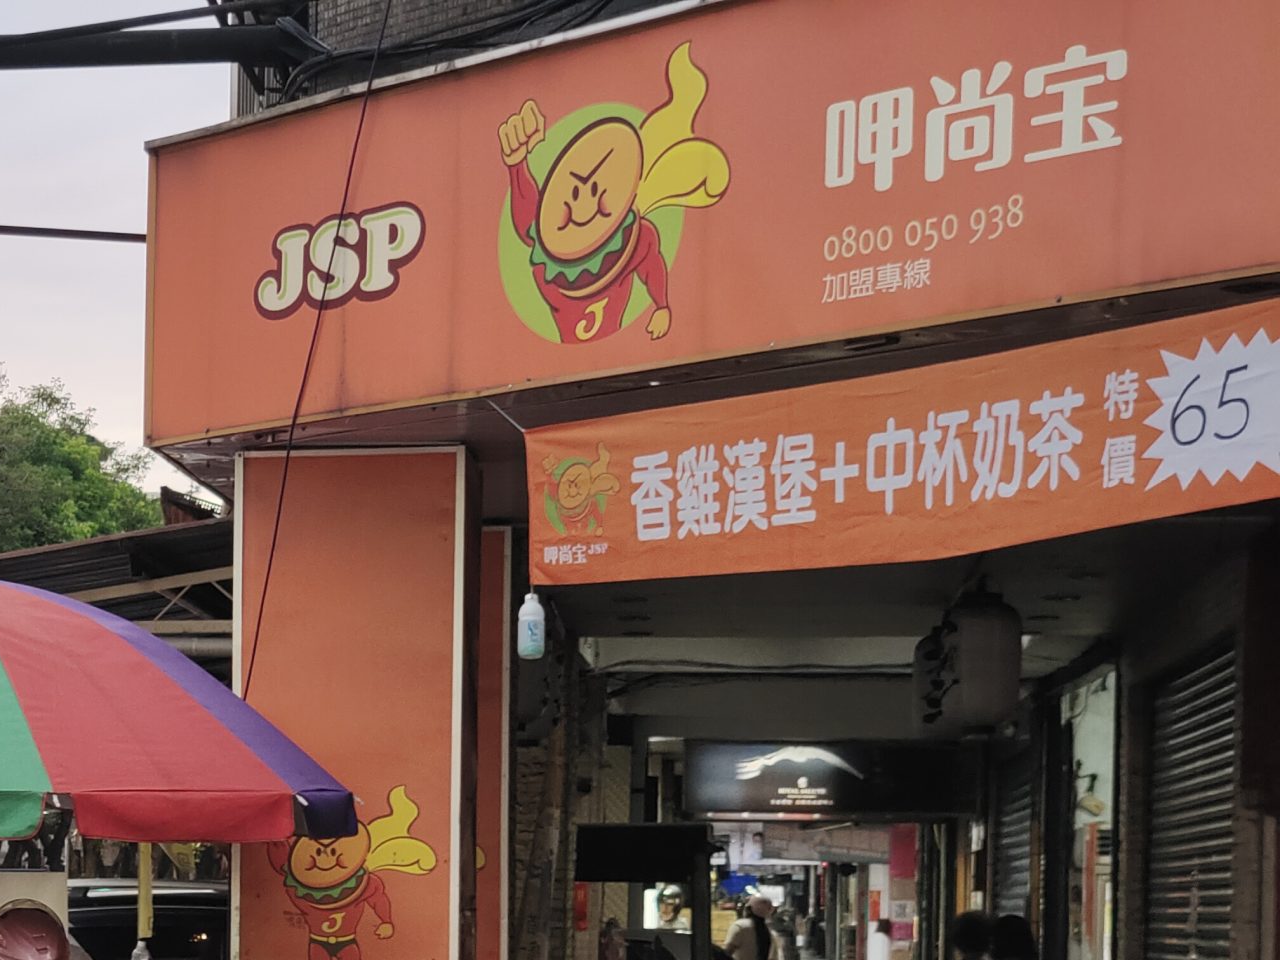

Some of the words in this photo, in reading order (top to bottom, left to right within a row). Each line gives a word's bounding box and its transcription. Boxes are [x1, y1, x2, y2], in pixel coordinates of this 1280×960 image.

[823, 44, 1128, 192] 呷尚宝
[255, 203, 425, 317] JSP
[821, 258, 932, 304] 加盟專線
[823, 226, 893, 262] 0800
[905, 213, 958, 252] 050
[969, 194, 1024, 245] 938
[1100, 369, 1139, 488] 特價
[1171, 364, 1249, 446] 65
[630, 386, 1086, 542] 香雞漢堡+中杯奶茶
